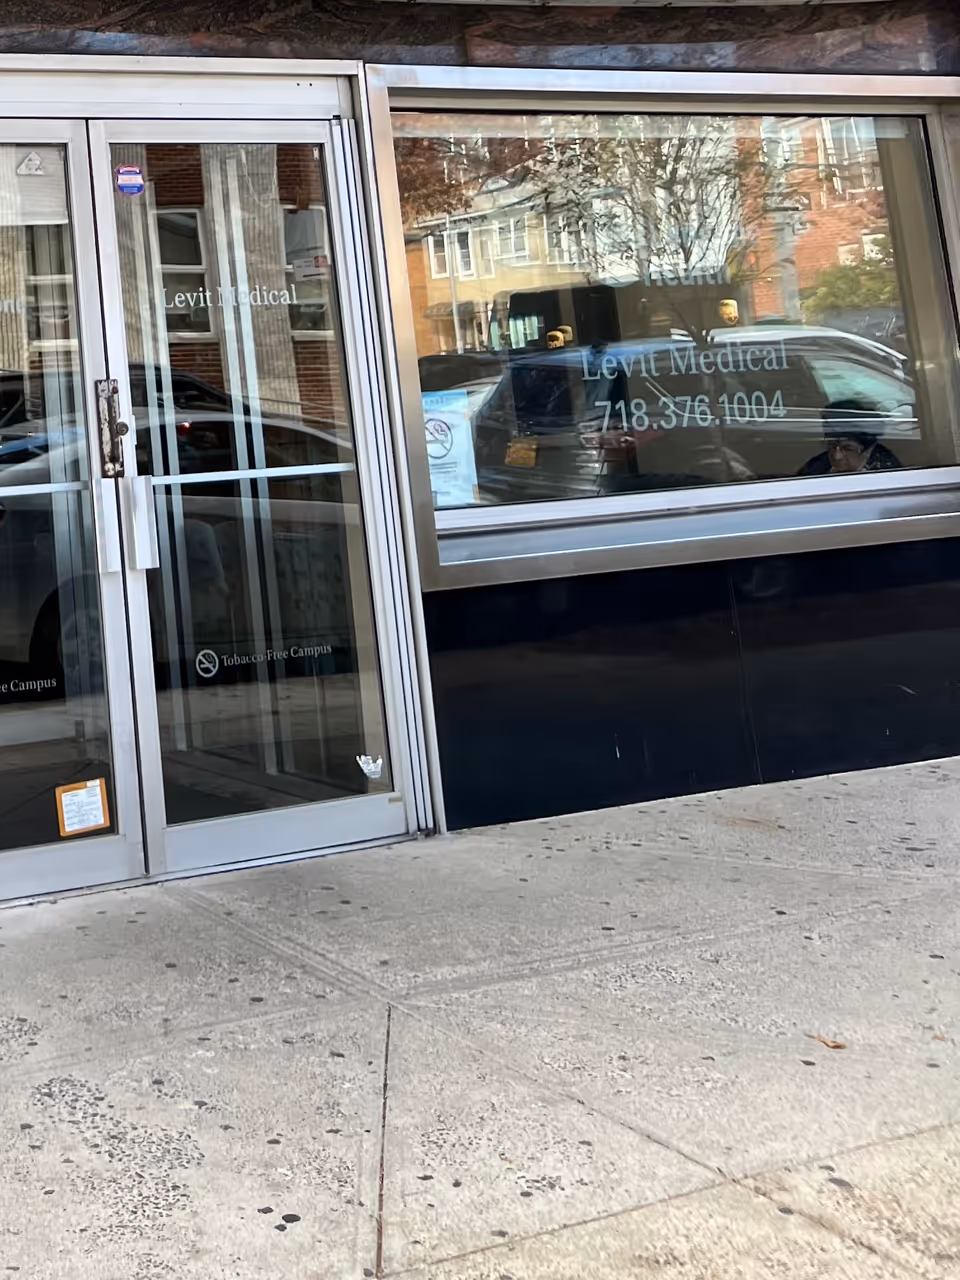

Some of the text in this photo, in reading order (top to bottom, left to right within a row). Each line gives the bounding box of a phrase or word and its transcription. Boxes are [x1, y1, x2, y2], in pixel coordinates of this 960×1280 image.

[162, 284, 298, 308] Levit Medical
[581, 339, 790, 381] Levit Medical
[595, 390, 788, 434] 718.376.1004
[221, 644, 332, 667] Tobacco-Free Campus
[10, 678, 57, 691] Campus
